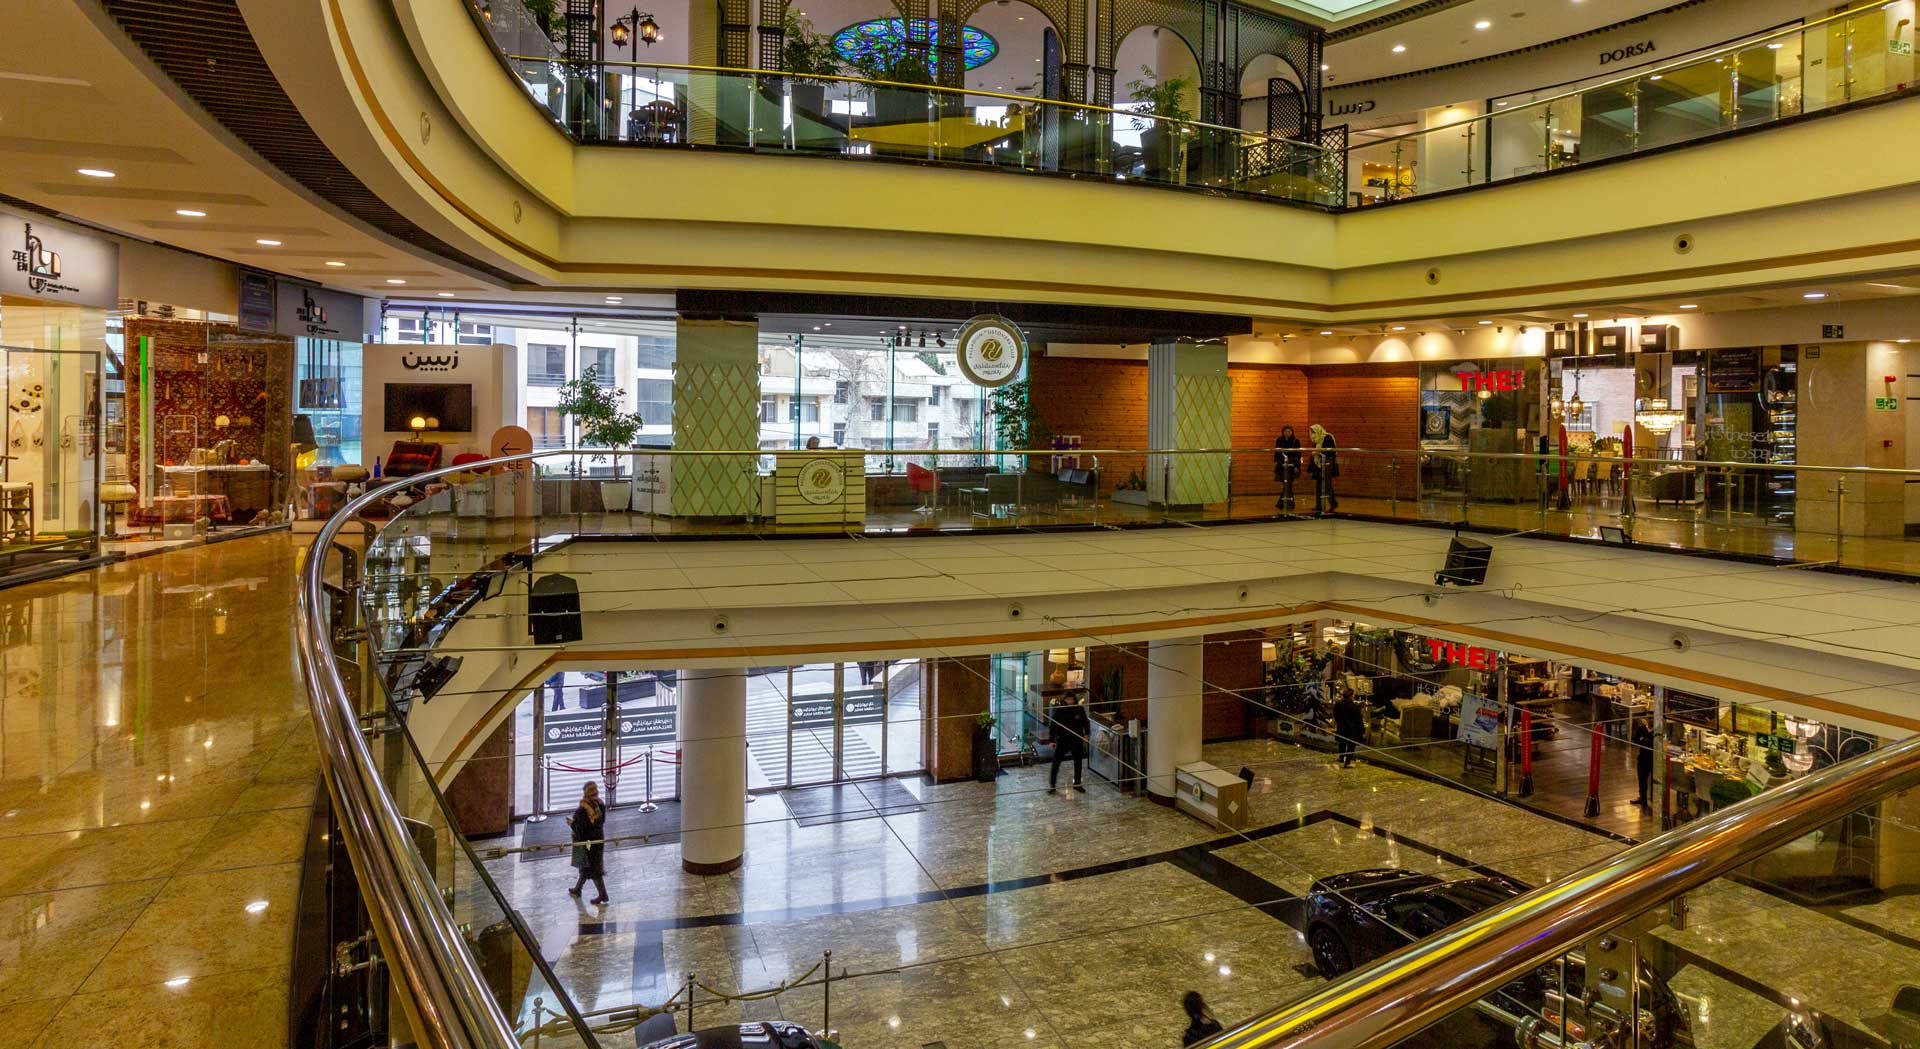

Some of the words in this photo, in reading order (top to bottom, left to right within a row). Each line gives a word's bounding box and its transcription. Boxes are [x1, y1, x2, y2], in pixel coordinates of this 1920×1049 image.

[1600, 40, 1656, 65] DORSA
[1329, 100, 1376, 117] درسا
[12, 249, 28, 262] ZEE
[17, 261, 29, 272] EN
